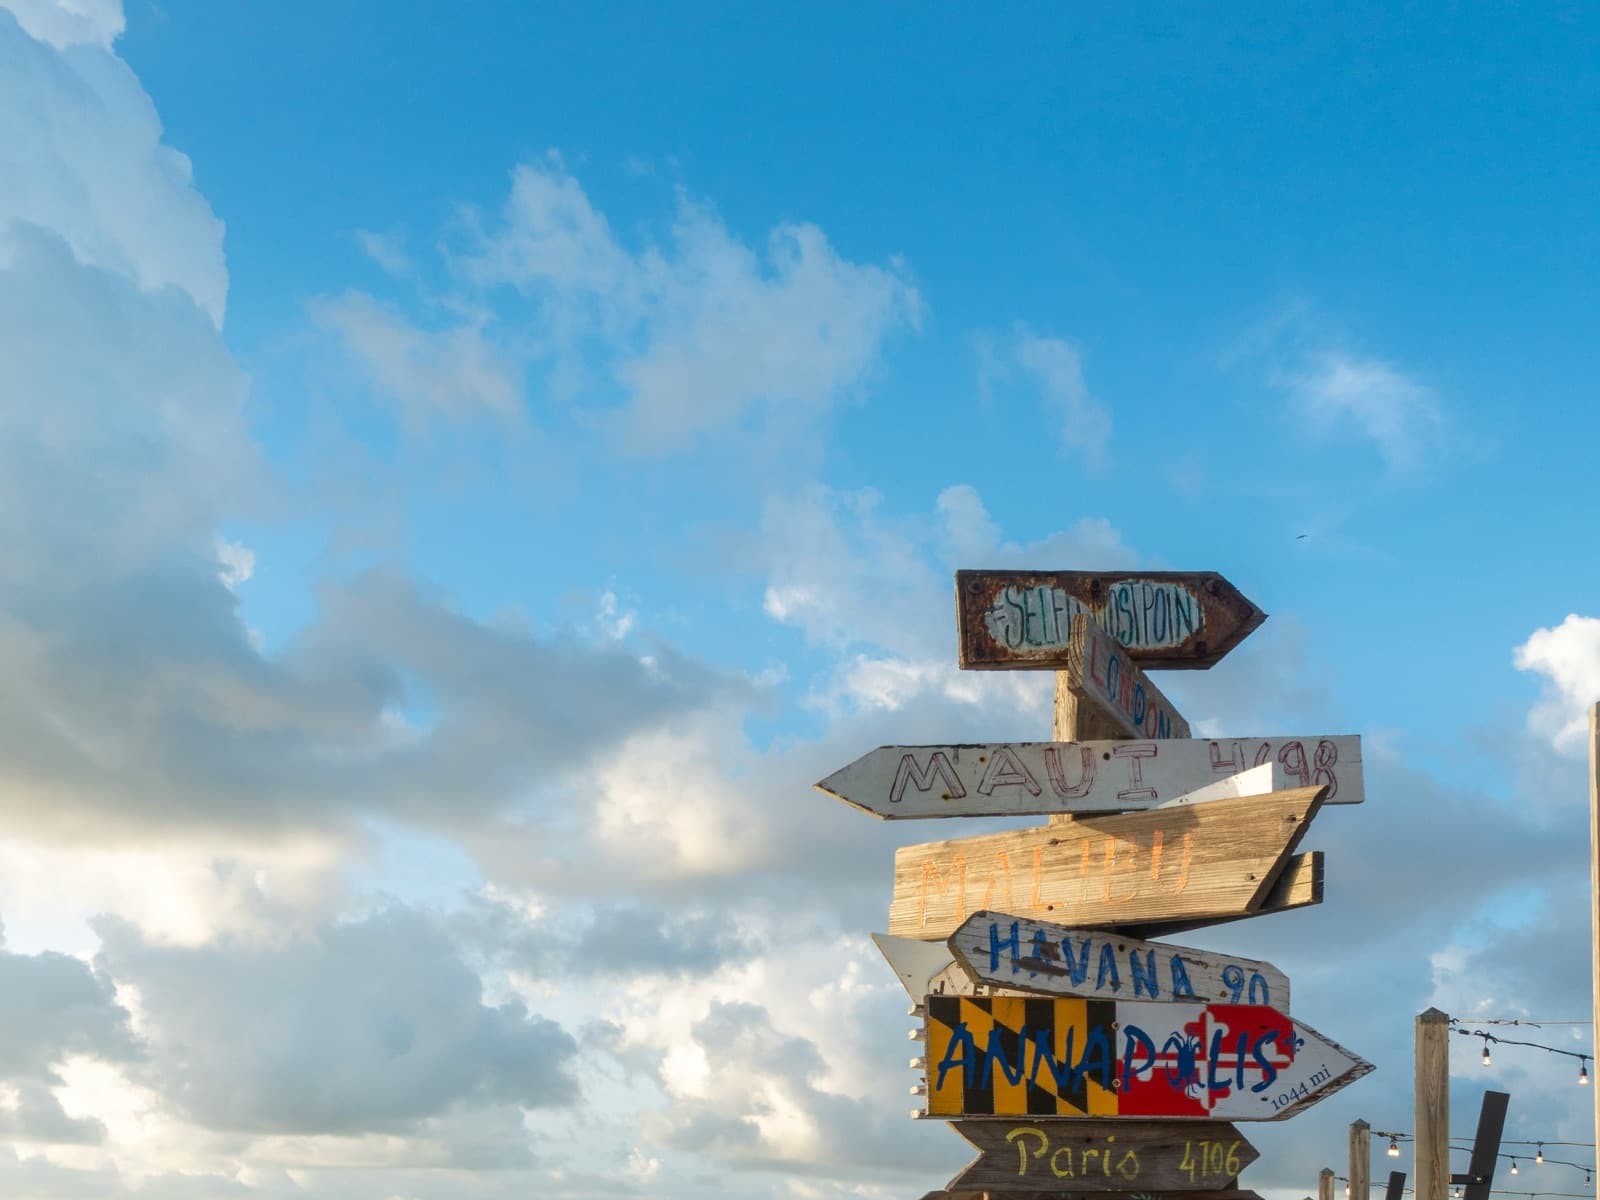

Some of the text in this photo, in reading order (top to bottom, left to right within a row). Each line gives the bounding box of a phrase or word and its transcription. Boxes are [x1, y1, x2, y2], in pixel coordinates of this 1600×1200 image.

[889, 743, 1158, 803] MAUI
[918, 829, 1194, 929] MALIBU
[989, 921, 1270, 1006] HAVANA 90
[1268, 1063, 1332, 1112] 1044 mi
[1006, 1127, 1141, 1181] Paris
